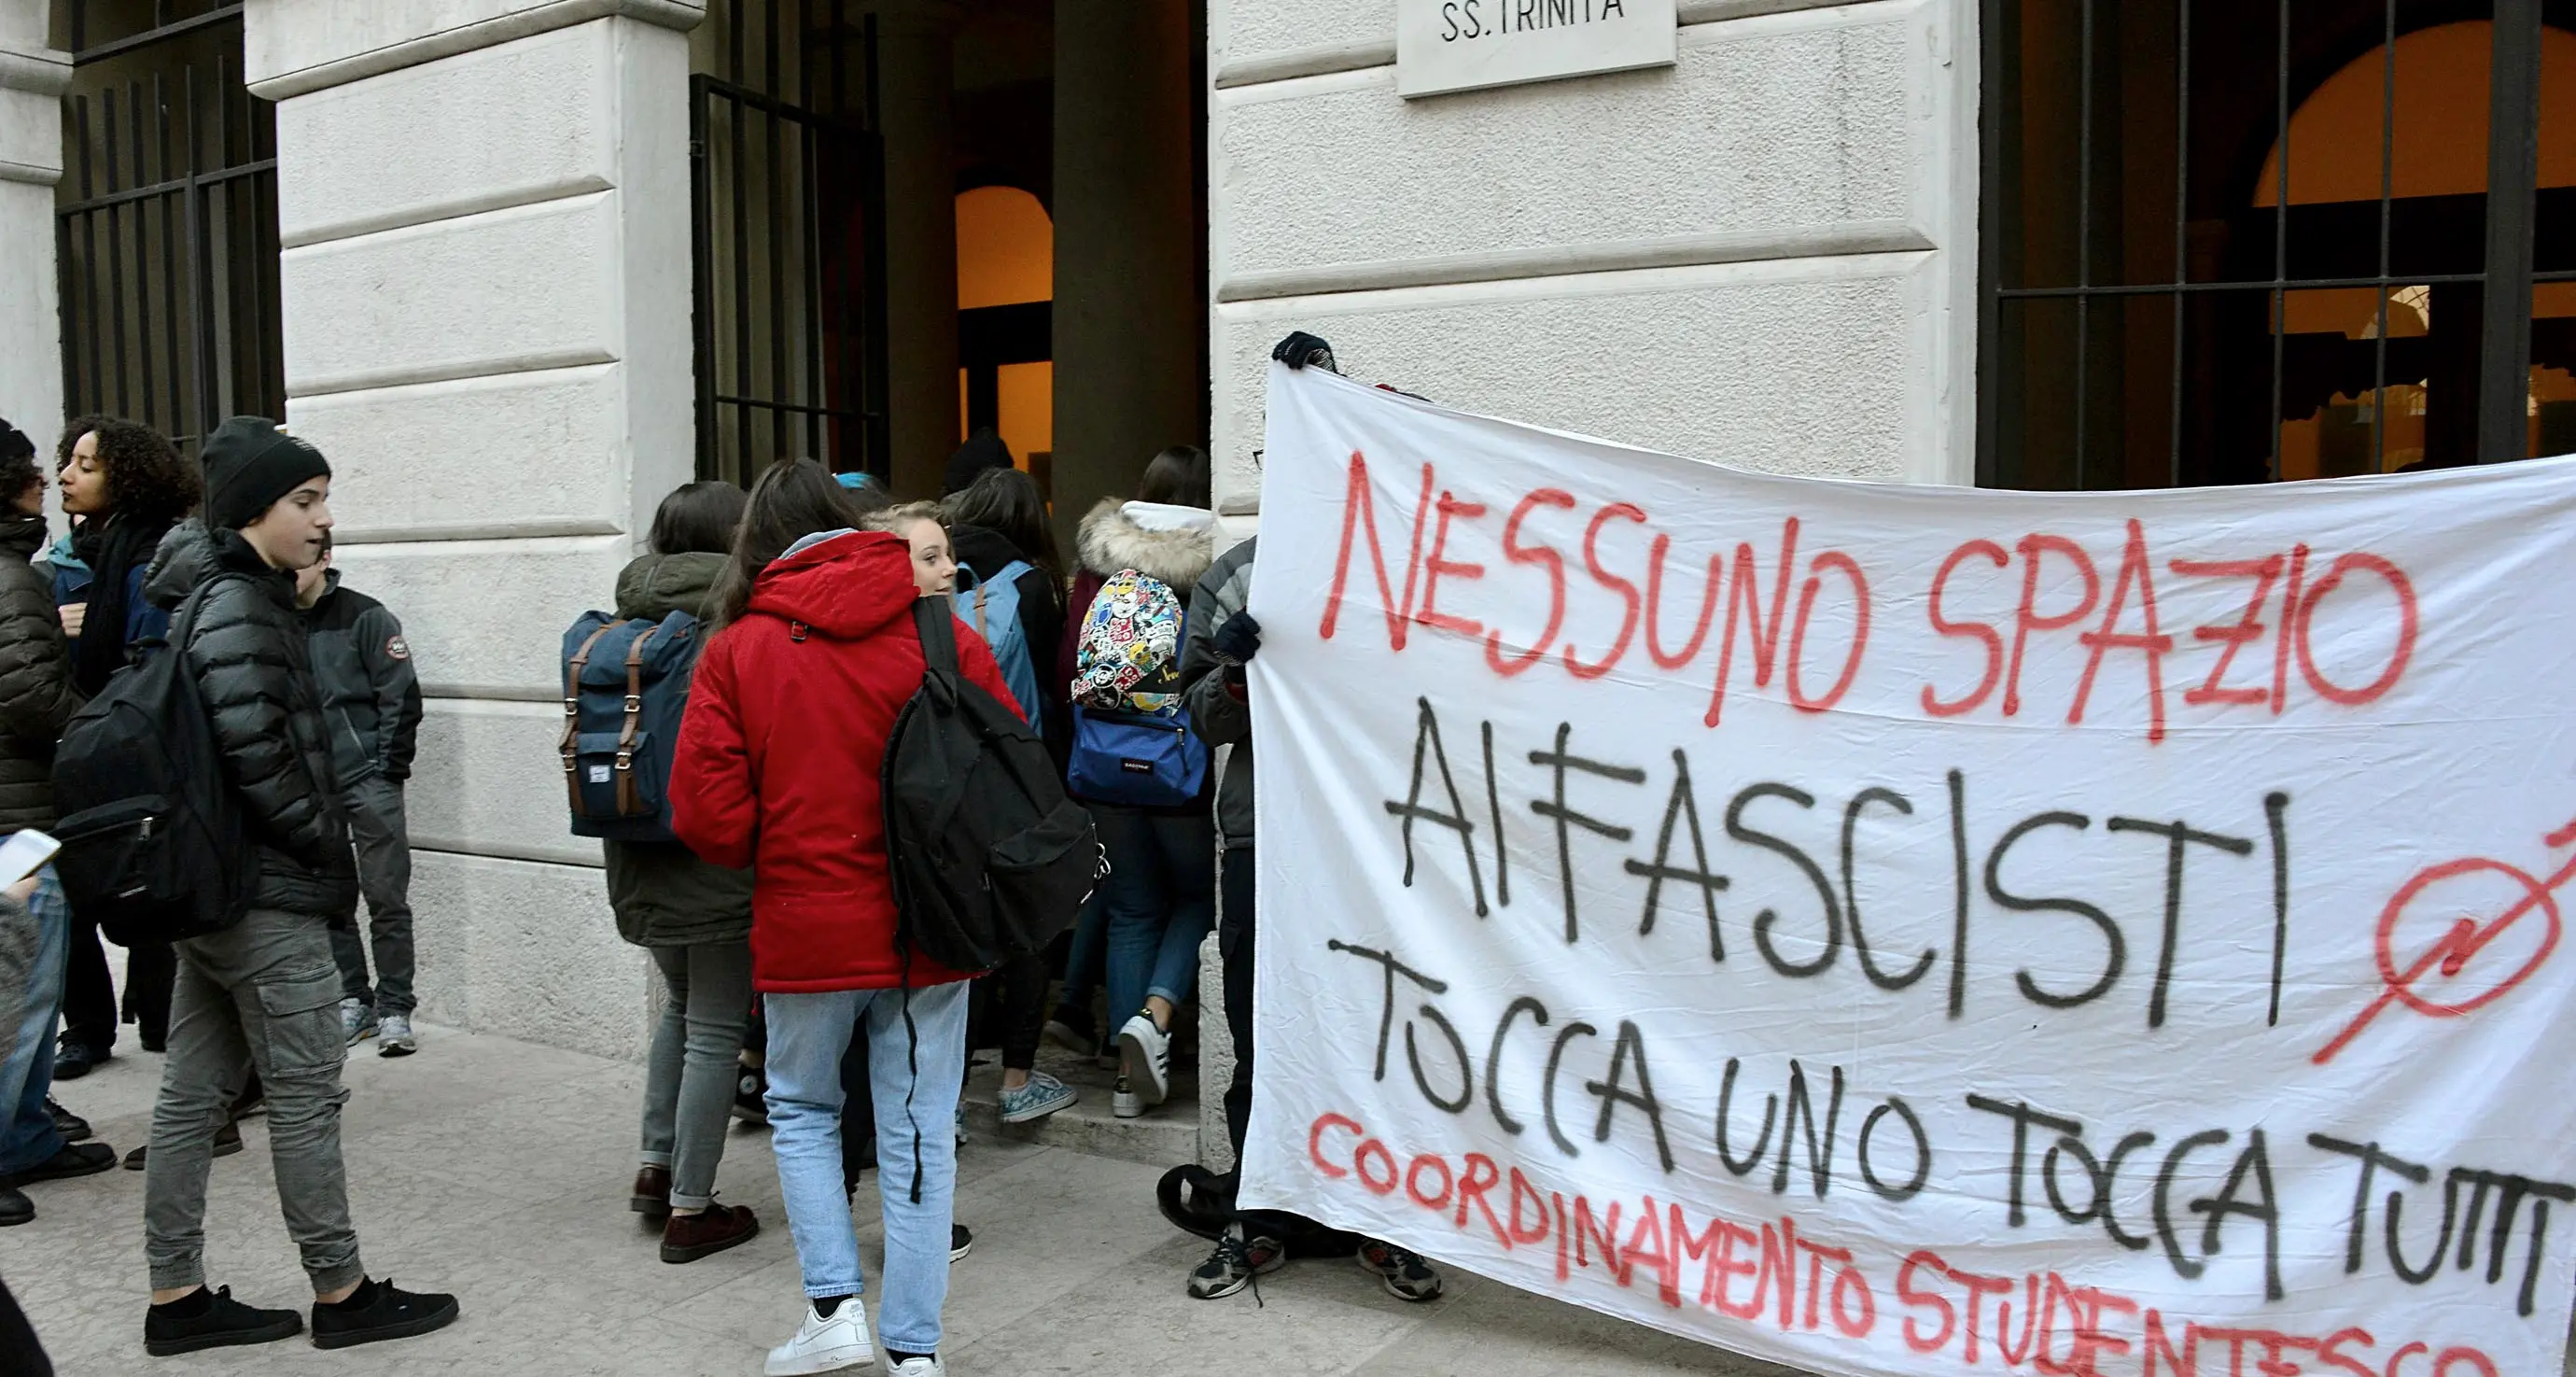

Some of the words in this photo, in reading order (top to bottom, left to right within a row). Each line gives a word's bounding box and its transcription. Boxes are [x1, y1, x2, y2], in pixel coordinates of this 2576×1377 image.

[1319, 450, 1870, 730] NESSUNO
[1921, 516, 2418, 746] SPAZIO
[1383, 695, 1511, 920] AI
[1528, 721, 2291, 1030] FASCISTI
[1309, 1112, 1876, 1339] COORDINAMENTO
[1327, 937, 1676, 1174] TOCCA
[1715, 1057, 1932, 1201] UNO
[1966, 1092, 2286, 1303] TOCCA
[2305, 1131, 2576, 1317] TUTTI
